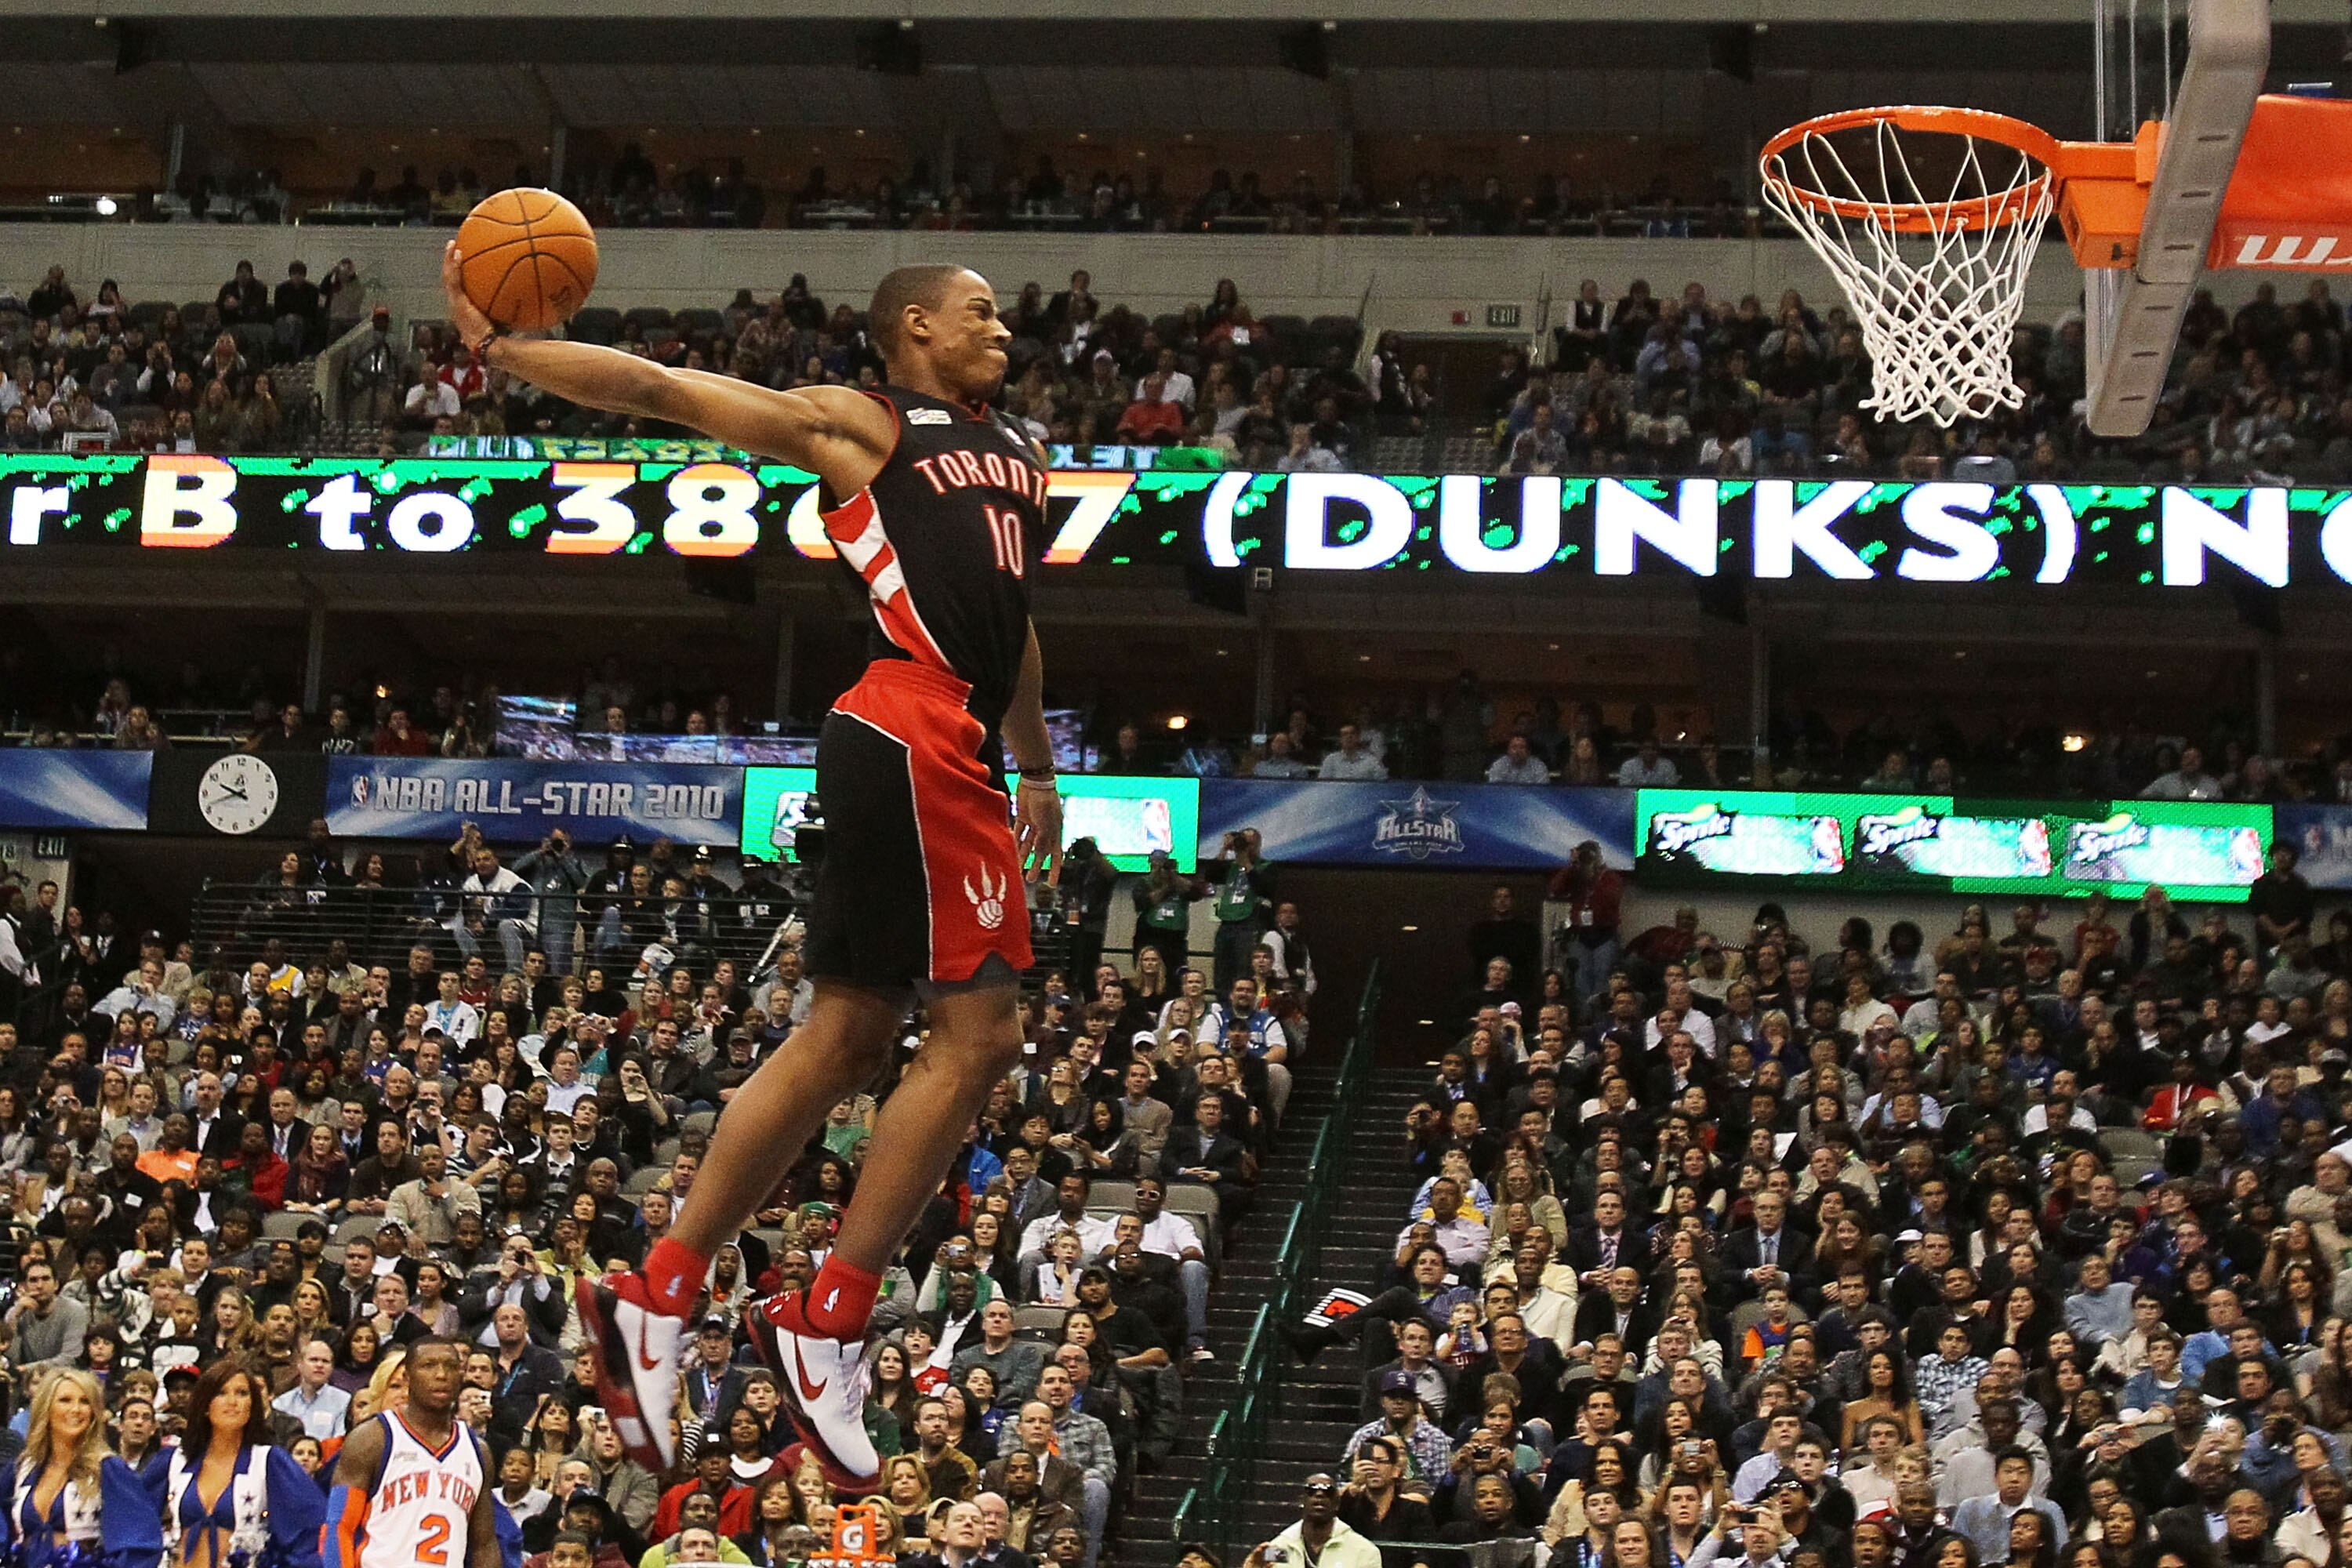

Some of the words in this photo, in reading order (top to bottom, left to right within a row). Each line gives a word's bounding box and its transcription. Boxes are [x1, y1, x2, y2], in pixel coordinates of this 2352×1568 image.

[10, 487, 69, 544] r
[141, 456, 237, 547] B
[306, 475, 475, 552] to
[1204, 472, 2077, 583] (DUNKS)
[2163, 487, 2352, 587] N
[982, 503, 1025, 579] 10
[375, 776, 445, 812] NBA
[454, 779, 633, 816] ALL-STAR
[644, 784, 725, 820] 2010
[381, 1469, 430, 1513] NEW
[415, 1513, 451, 1566] 2
[841, 1523, 866, 1550] G
